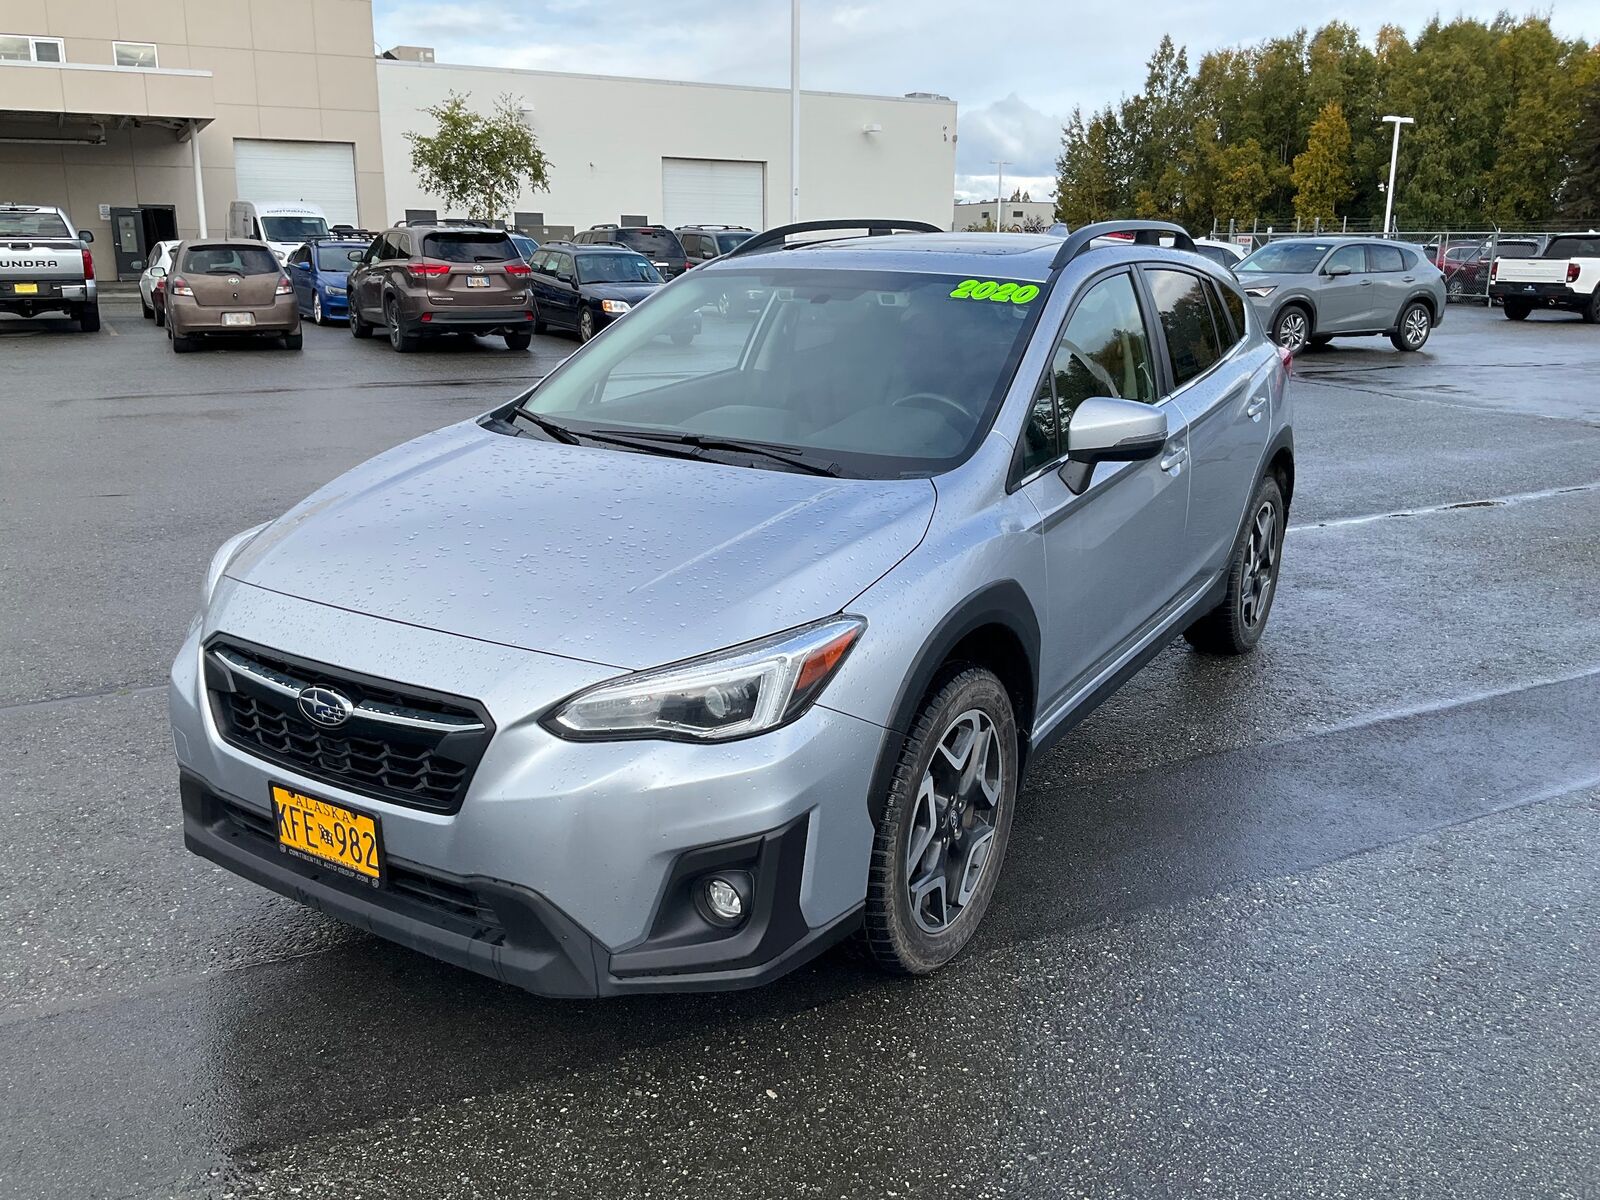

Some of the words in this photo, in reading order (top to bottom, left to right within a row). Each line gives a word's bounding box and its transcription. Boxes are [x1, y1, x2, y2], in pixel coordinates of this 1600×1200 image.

[950, 279, 1040, 304] 2020
[296, 796, 351, 824] ALASKA
[276, 801, 319, 849] KFE
[333, 821, 380, 870] 982
[288, 848, 322, 866] CONTINENTAL
[323, 861, 337, 872] AUTO
